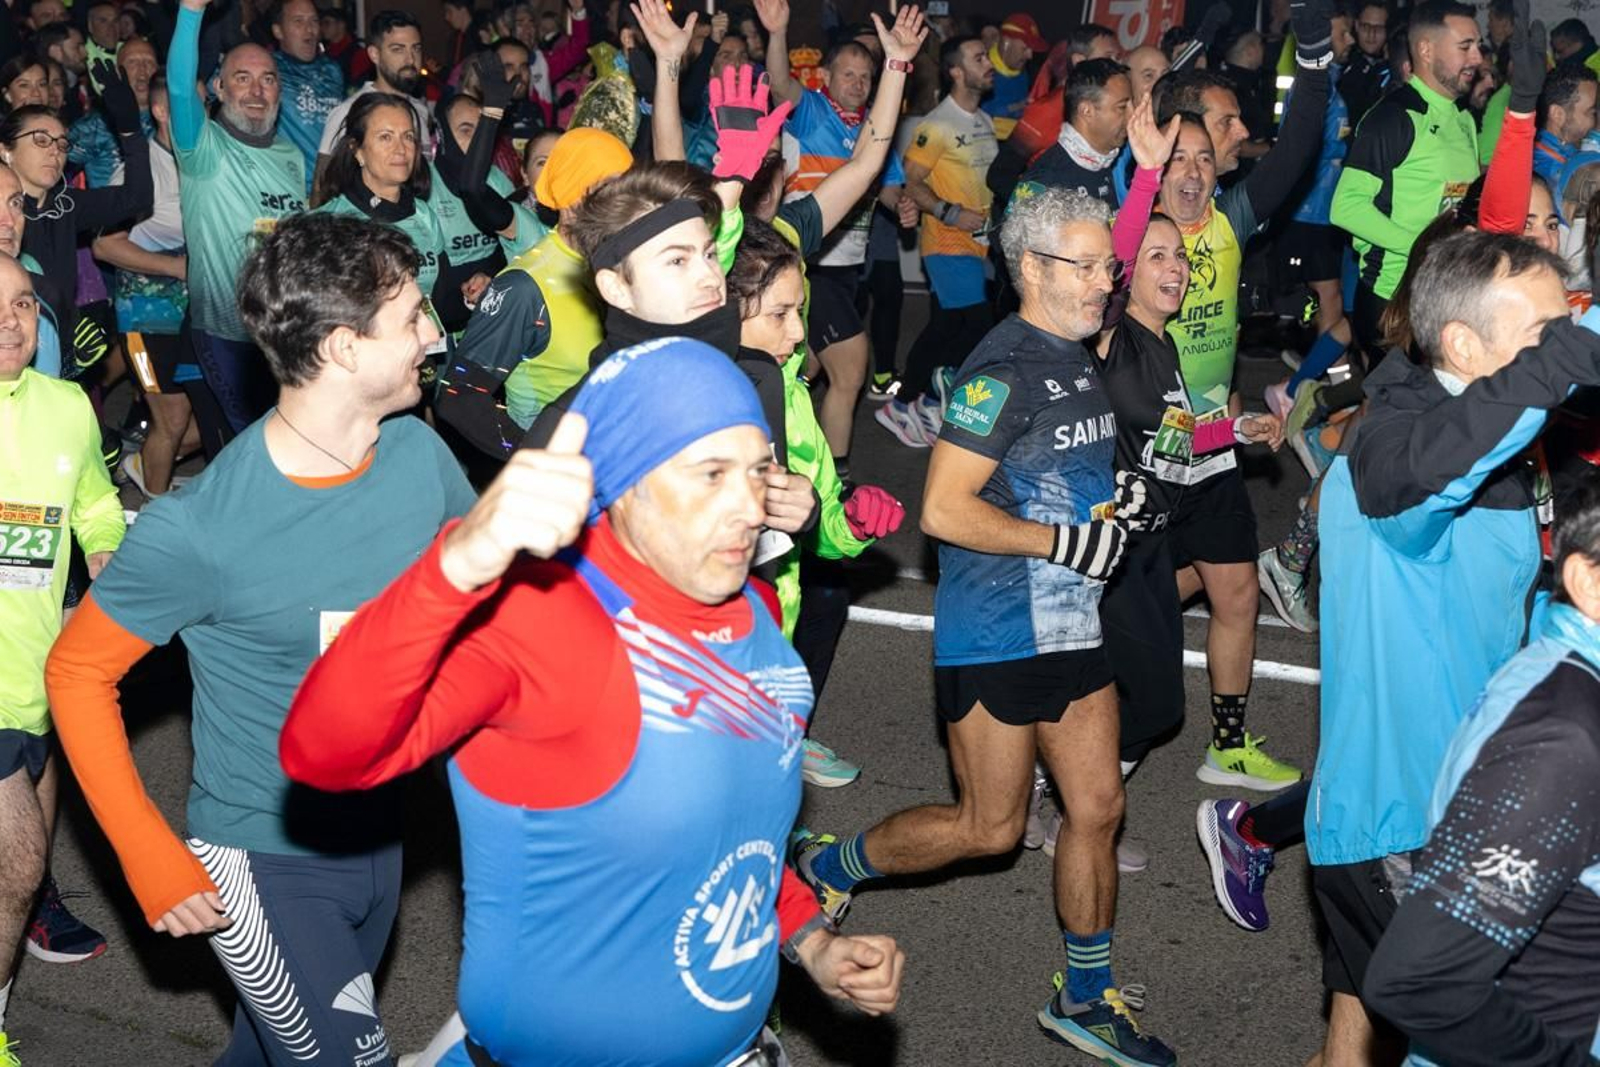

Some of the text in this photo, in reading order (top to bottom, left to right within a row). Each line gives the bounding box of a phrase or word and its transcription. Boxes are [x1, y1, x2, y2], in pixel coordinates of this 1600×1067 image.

[1177, 300, 1224, 324] LINCE
[1053, 416, 1098, 450] SAN
[673, 906, 700, 968] ACTIVA
[694, 853, 734, 904] SPORT
